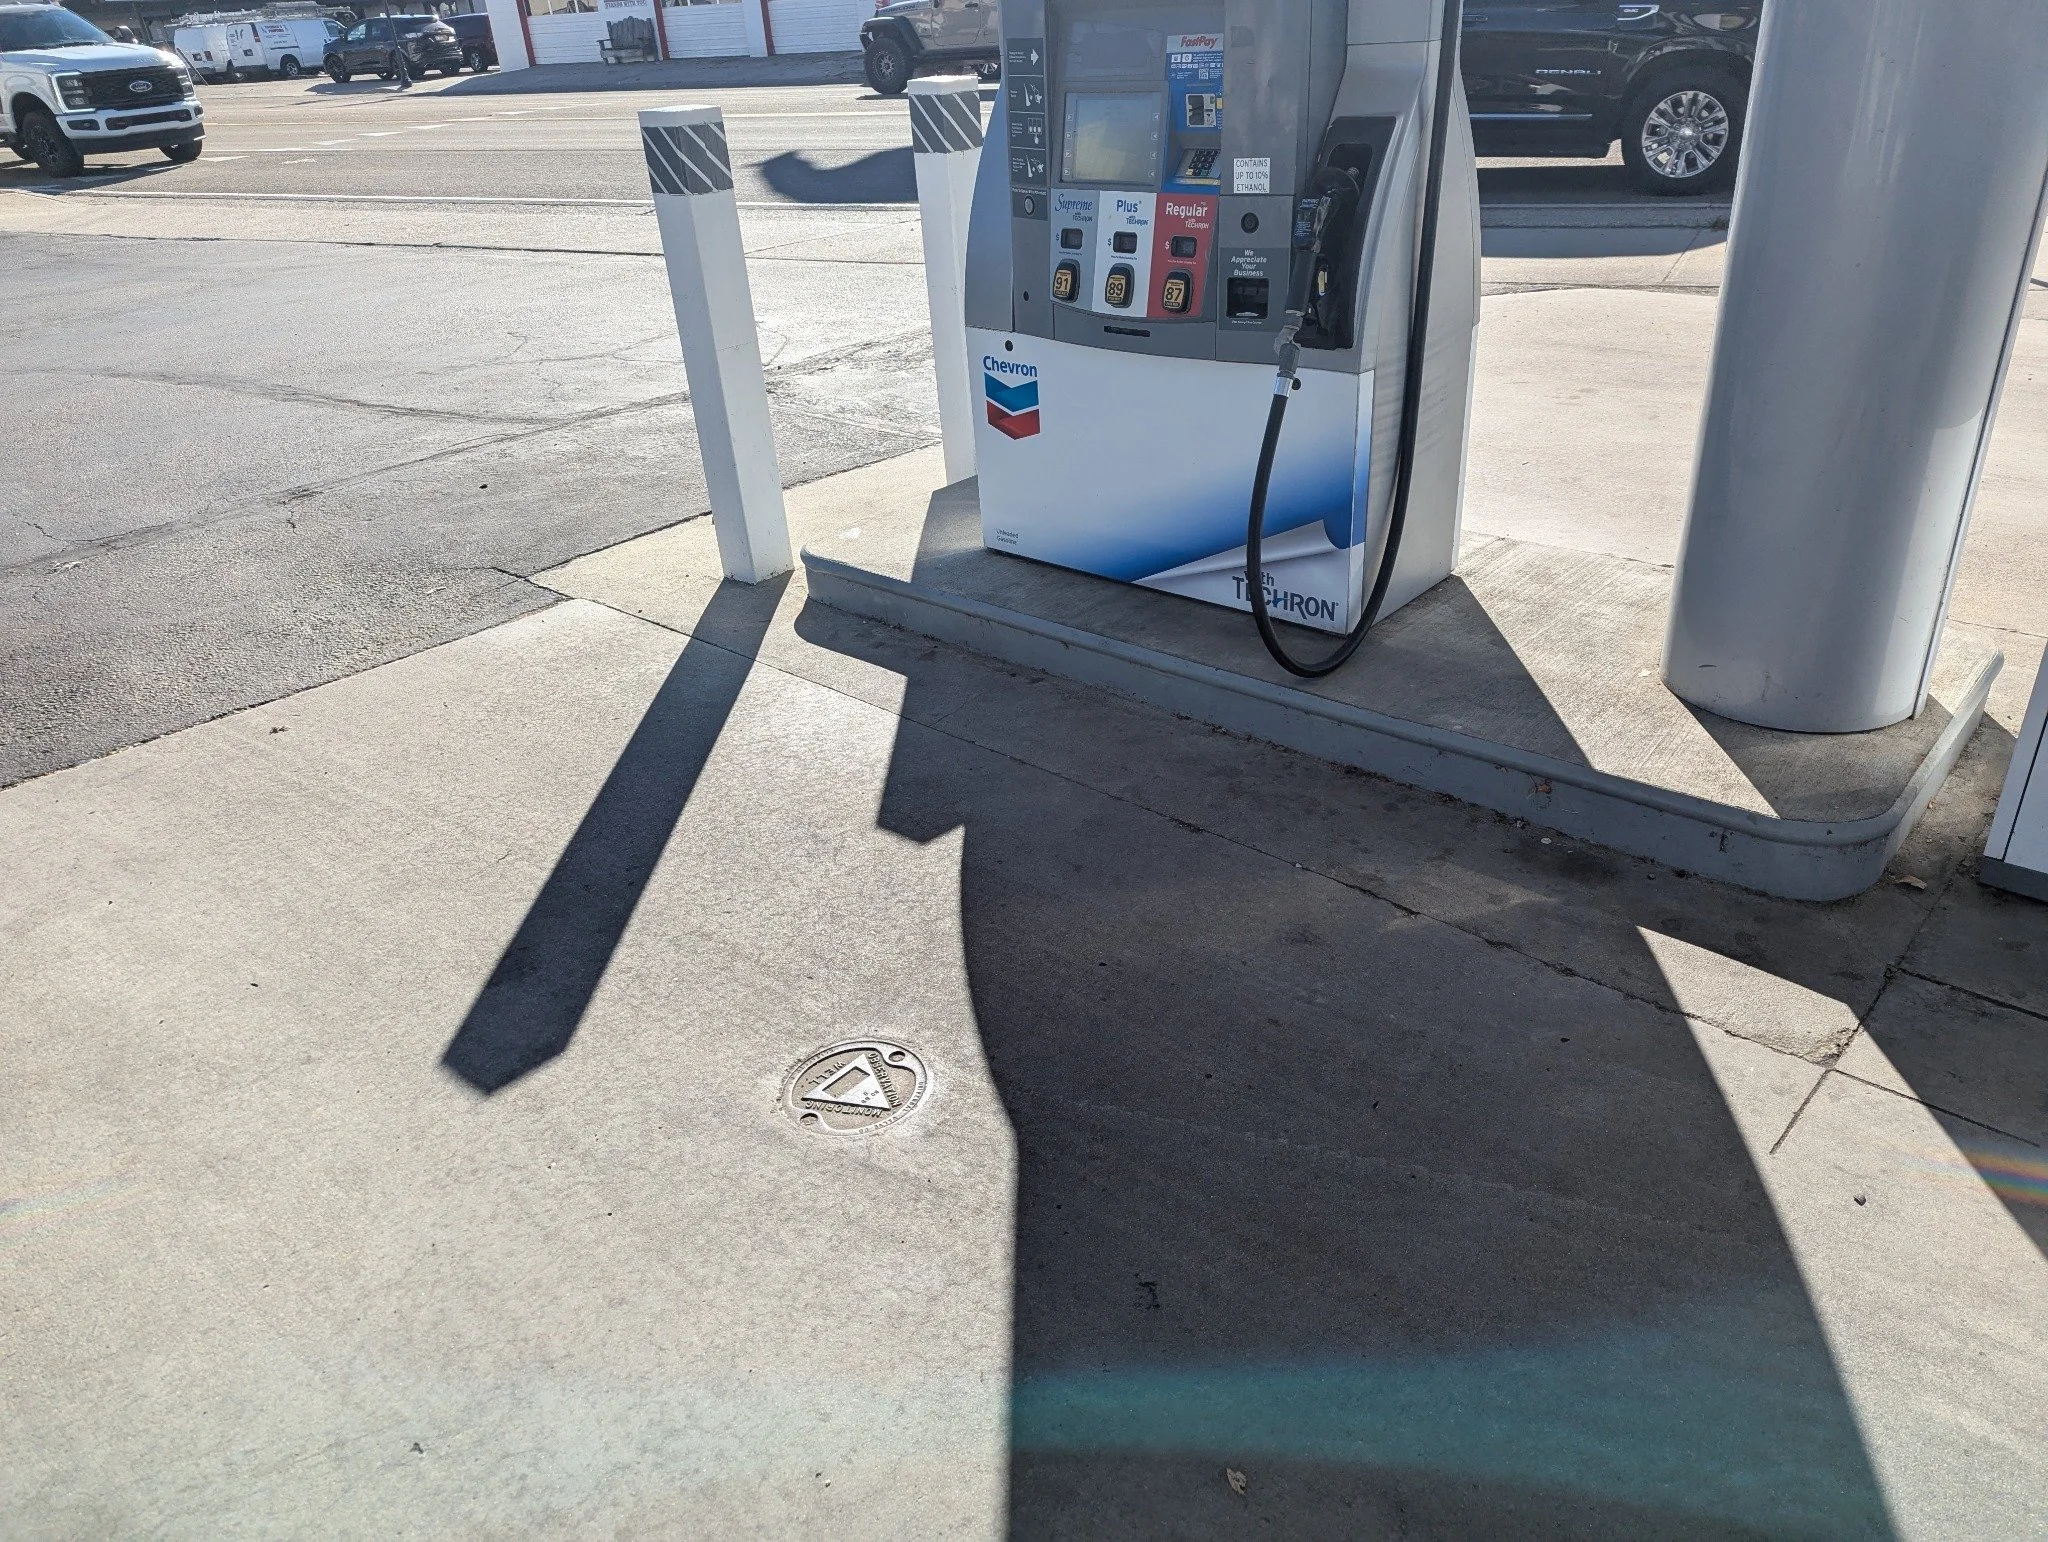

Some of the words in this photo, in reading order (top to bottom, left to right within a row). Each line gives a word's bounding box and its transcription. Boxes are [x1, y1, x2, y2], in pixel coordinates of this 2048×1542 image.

[1181, 35, 1218, 49] FastPay
[1235, 159, 1268, 168] CONTAINS
[1236, 172, 1244, 180] UP
[1246, 172, 1254, 180] TO
[1255, 171, 1268, 180] 10%
[1236, 183, 1267, 192] ETHANOL
[1054, 193, 1093, 213] Supreme
[1116, 199, 1139, 213] Plus
[1165, 202, 1208, 219] Regular
[1072, 215, 1093, 223] TECHRON
[1126, 217, 1149, 226] TECHRON
[1184, 220, 1210, 230] TECHRON
[1055, 232, 1060, 241] $
[1107, 237, 1112, 246] $
[1164, 240, 1170, 250] $
[1231, 255, 1267, 264] Appreciate
[1241, 262, 1257, 270] Your
[1233, 269, 1264, 277] Business
[1055, 276, 1068, 290] 91
[1108, 282, 1123, 296] 89
[1165, 286, 1182, 301] 87
[982, 355, 1038, 378] Chevron
[996, 535, 1018, 546] Gasoline
[808, 1061, 847, 1086] WELL
[867, 1052, 903, 1108] OBSERVATION
[805, 1100, 883, 1118] MONITORING
